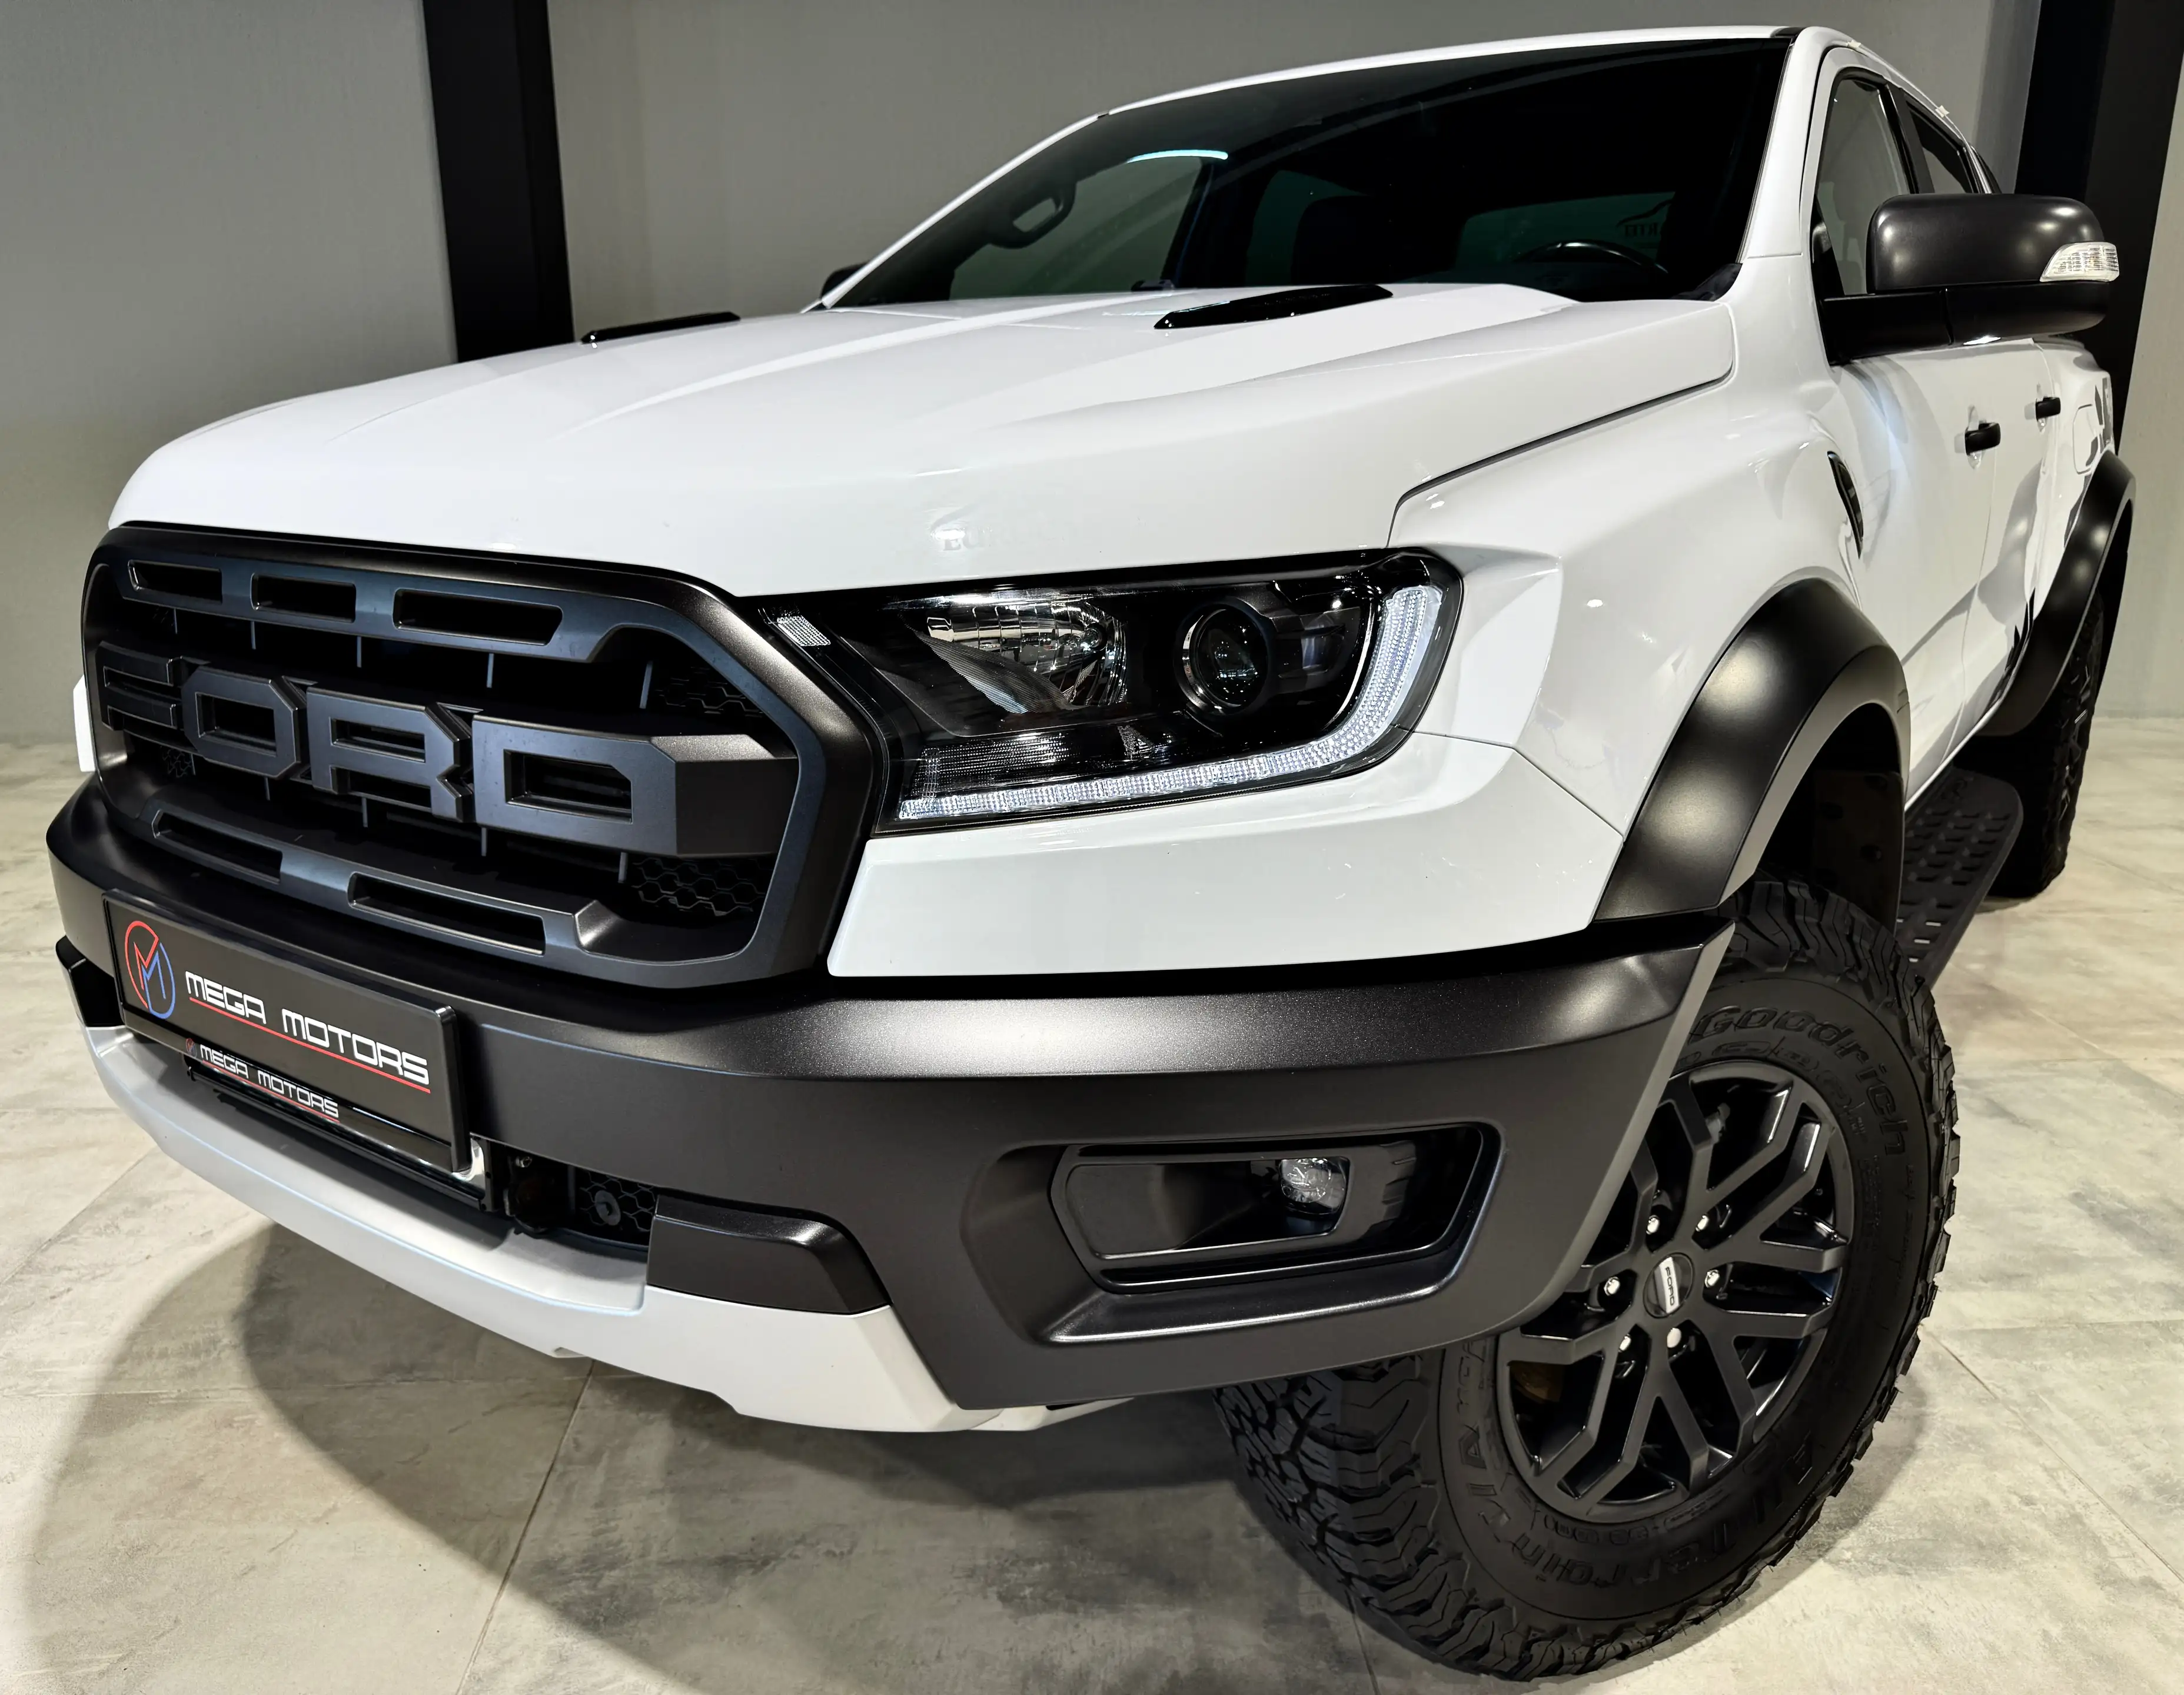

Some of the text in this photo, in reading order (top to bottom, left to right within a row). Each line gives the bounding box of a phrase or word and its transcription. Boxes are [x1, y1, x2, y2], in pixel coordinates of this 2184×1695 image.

[95, 640, 678, 857] FORD
[185, 971, 430, 1085] MEGA MOTORS
[200, 1043, 250, 1079] MEGA
[257, 1069, 339, 1118] MOTORS
[1665, 1266, 1676, 1307] FORD
